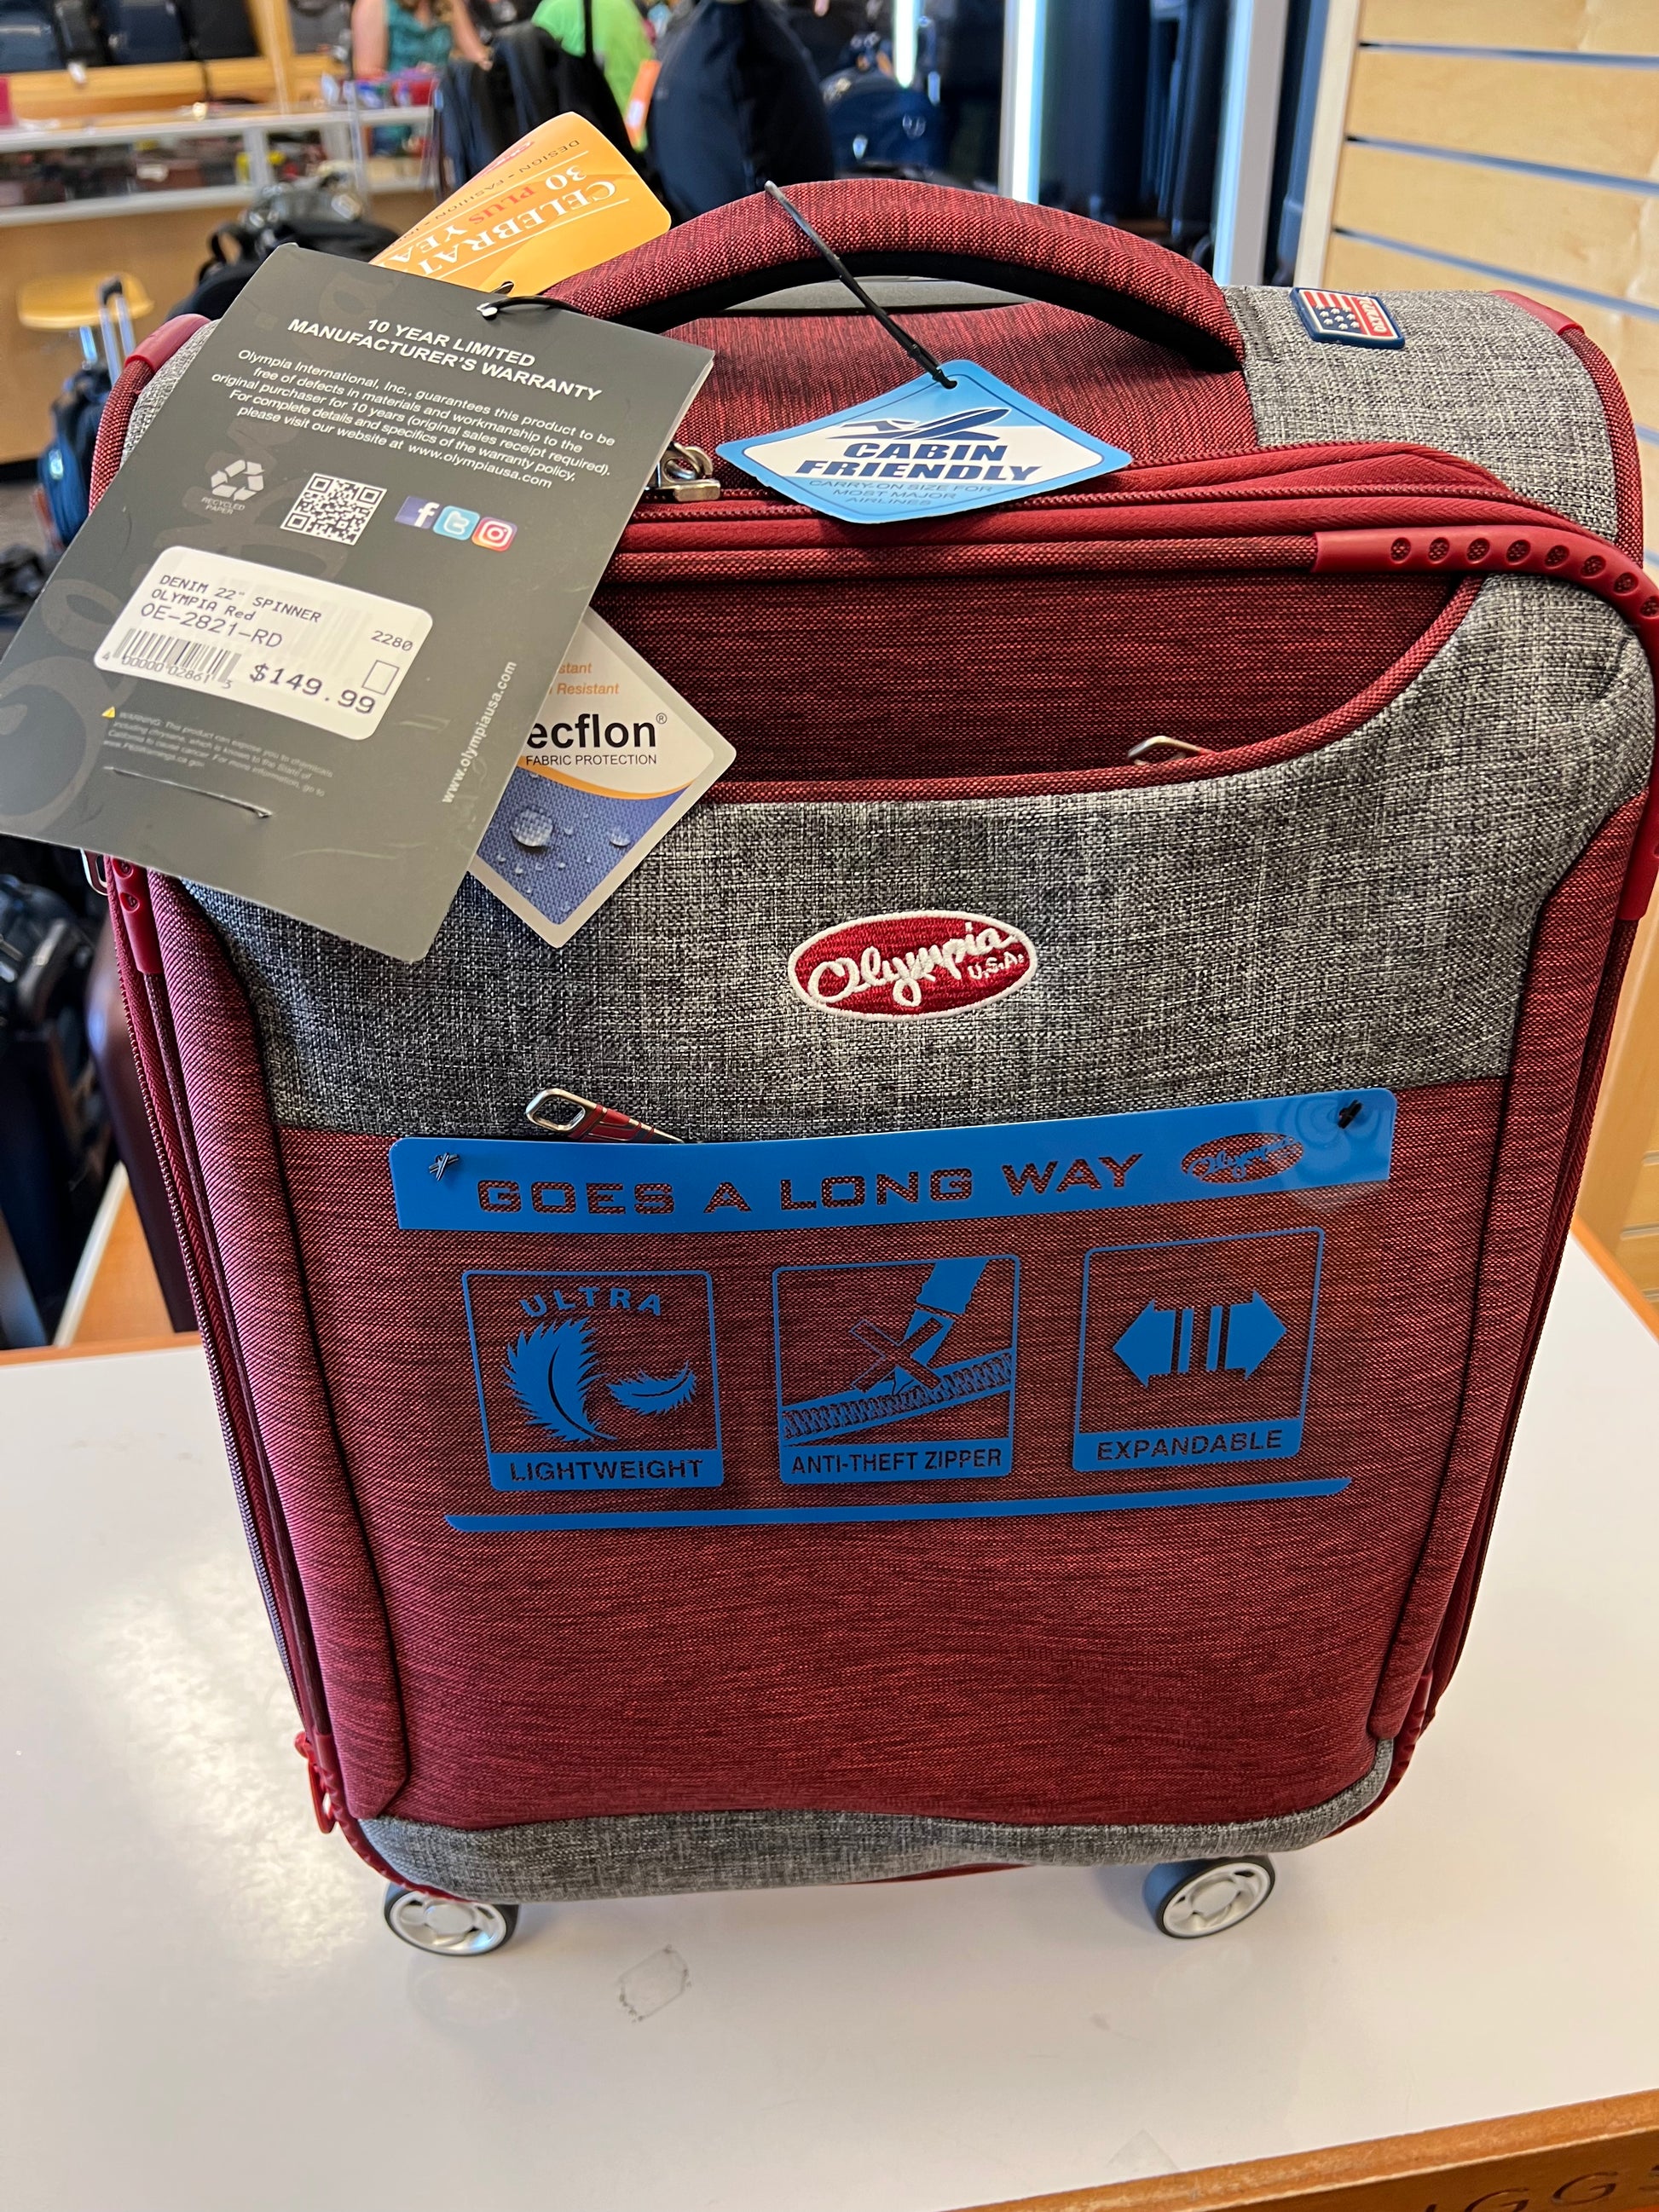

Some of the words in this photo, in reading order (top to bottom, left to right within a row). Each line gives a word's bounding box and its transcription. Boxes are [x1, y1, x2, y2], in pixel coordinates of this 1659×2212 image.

[518, 139, 581, 174] DESIGN
[545, 165, 587, 190] 30
[468, 186, 536, 225] PLUS
[378, 225, 468, 268] YEA
[287, 319, 477, 372] MANUFACTURER'S
[481, 362, 603, 401] WARRANTY
[367, 319, 390, 333] 10
[395, 324, 451, 348] YEAR
[452, 338, 535, 367] LIMITED
[238, 349, 293, 370] Olympia
[294, 361, 380, 390] International,
[384, 381, 412, 397] Inc.,
[414, 390, 491, 415] guarantees
[494, 407, 520, 422] this
[521, 415, 576, 436] product
[579, 429, 594, 441] to
[596, 433, 616, 447] be
[252, 367, 279, 381] free
[280, 374, 298, 384] of
[297, 377, 345, 396] defects
[347, 387, 360, 399] in
[361, 393, 422, 413] materials
[423, 406, 452, 419] and
[453, 413, 541, 443] workmanship
[543, 435, 558, 447] to
[560, 440, 583, 453] the
[211, 373, 261, 391] original
[258, 384, 327, 405] purchaser
[328, 396, 349, 409] for
[351, 401, 368, 413] 10
[367, 407, 406, 423] years
[407, 414, 461, 436] (original
[461, 430, 498, 446] sales
[499, 438, 547, 459] receipt
[547, 452, 610, 476] required).
[229, 389, 253, 403] For
[252, 396, 311, 416] complete
[312, 407, 355, 425] details
[354, 418, 382, 431] and
[380, 424, 437, 445] specifics
[438, 437, 455, 448] of
[454, 440, 477, 454] the
[478, 447, 535, 471] warranty
[534, 463, 576, 482] policy,
[237, 406, 281, 423] please
[284, 415, 311, 430] visit
[312, 422, 336, 434] our
[337, 427, 388, 447] website
[389, 439, 405, 450] at
[408, 443, 552, 489] www.olympiausa.com
[842, 442, 1009, 462] CABIN
[795, 459, 1043, 482] FRIENDLY
[809, 480, 899, 490] CARRY-ON
[907, 483, 948, 492] SIZE
[953, 484, 993, 493] FOR
[201, 497, 246, 511] RECYCLED
[205, 505, 234, 516] PAPER
[832, 489, 888, 498] MOST
[893, 490, 957, 500] MAJOR
[845, 497, 933, 505] AIRLINES
[151, 588, 218, 614] OLYMPIA
[225, 603, 257, 622] Red
[159, 574, 210, 594] DENIM
[251, 596, 322, 624] SPINNER
[140, 602, 284, 650] OE-2821-RD
[371, 630, 414, 653] 2280
[167, 664, 211, 684] 02861
[249, 661, 377, 716] $149.99
[556, 682, 620, 695] Resistant
[182, 726, 215, 739] product
[215, 734, 231, 744] can
[441, 660, 517, 805] www.olympiausa.com
[525, 754, 572, 766] FABRIC
[575, 754, 657, 765] PROTECTION
[808, 921, 1020, 1007] Olympia
[476, 1180, 676, 1216] GOES
[702, 1181, 753, 1215] A
[780, 1168, 974, 1211] LONG
[1001, 1152, 1145, 1197] WAY
[517, 1285, 663, 1318] ULTRA
[791, 1450, 916, 1476] ANTI-THEFT
[923, 1447, 1003, 1472] ZIPPER
[1095, 1429, 1284, 1464] EXPANDABLE
[509, 1458, 705, 1484] LIGHTWEIGHT
